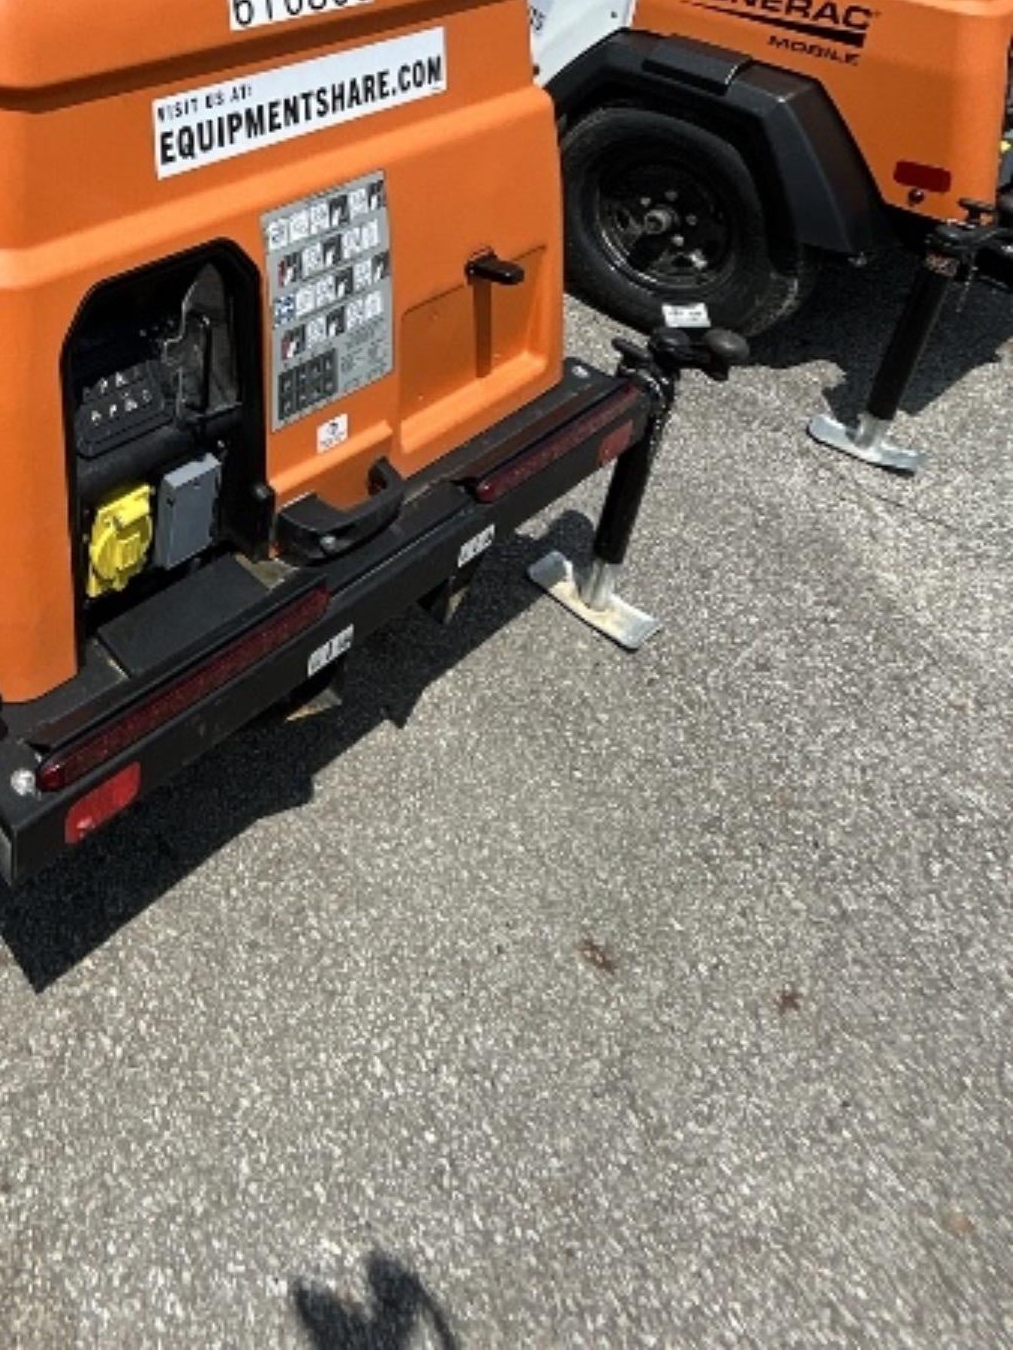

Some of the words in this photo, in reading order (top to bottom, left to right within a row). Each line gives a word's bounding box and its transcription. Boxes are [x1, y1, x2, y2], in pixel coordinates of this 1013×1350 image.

[766, 36, 861, 67] MOBILE
[157, 98, 199, 123] VISIT
[160, 54, 442, 165] EQUIPMENTSHARE.COM
